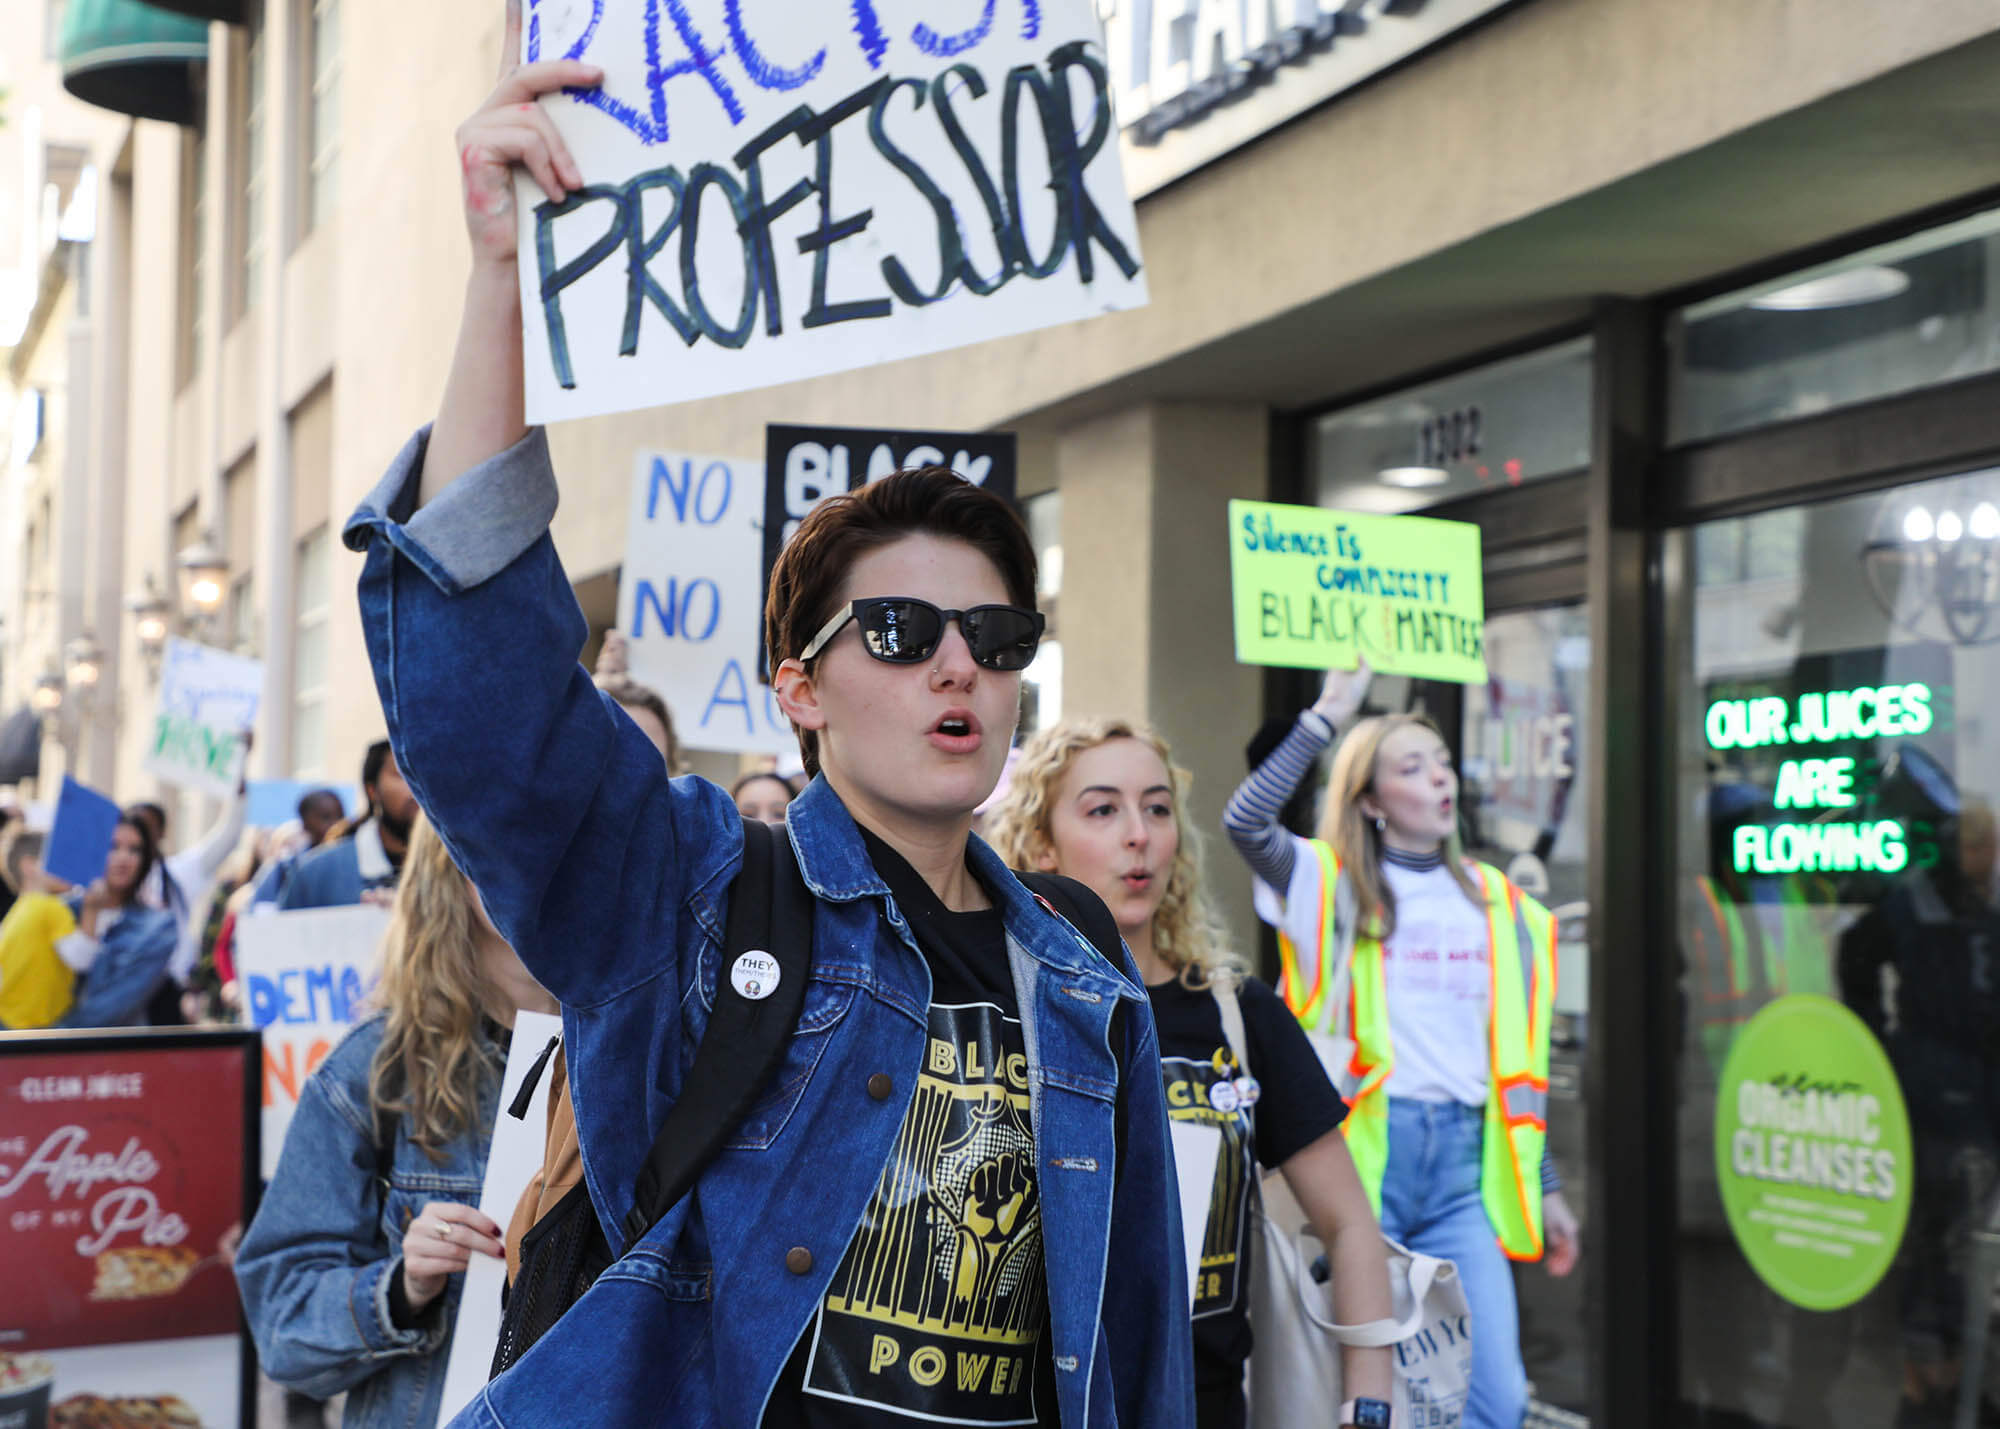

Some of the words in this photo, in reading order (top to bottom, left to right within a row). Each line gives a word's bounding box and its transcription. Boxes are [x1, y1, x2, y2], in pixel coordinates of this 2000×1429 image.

[528, 0, 1043, 147] RACI
[532, 40, 1140, 390] PROFESSOR
[646, 455, 734, 526] NO
[631, 576, 721, 641] NO
[1260, 590, 1382, 655] BLACK
[1704, 696, 1790, 750] OUR
[1788, 682, 1935, 744] JUICES
[1772, 756, 1857, 810] ARE
[1732, 819, 1910, 874] FLOWING
[741, 957, 775, 971] THEY
[1737, 1079, 1881, 1145] ORGANIC
[0, 1135, 26, 1156] HE
[0, 1124, 160, 1201] Apple
[1732, 1128, 1897, 1201] CLEANSES
[10, 1209, 42, 1231] OF
[75, 1185, 189, 1257] Pie
[868, 1333, 1023, 1395] POWER
